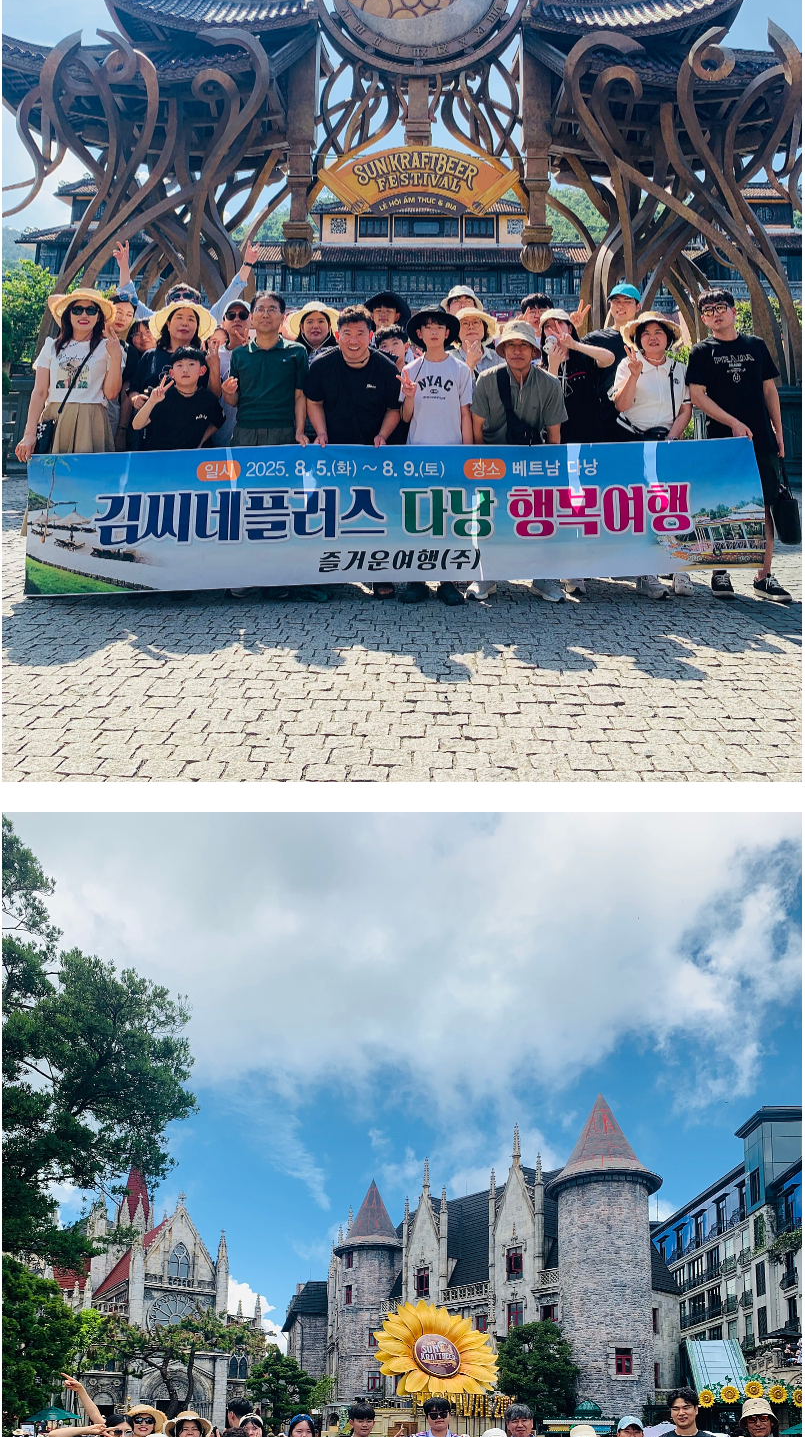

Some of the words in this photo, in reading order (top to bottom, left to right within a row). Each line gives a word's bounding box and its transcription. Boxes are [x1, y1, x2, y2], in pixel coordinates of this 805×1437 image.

[353, 157, 389, 185] SUN
[376, 172, 461, 192] FESTIVAL
[418, 376, 454, 392] NYAC
[205, 463, 233, 479] 일시
[246, 461, 288, 477] 2025.
[472, 461, 501, 477] 장소
[512, 459, 560, 476] 베트남
[568, 459, 598, 476] 다낭
[94, 488, 387, 546] 김씨네플러스
[402, 487, 495, 537] 다낭
[508, 482, 694, 538] 행복여행
[318, 548, 481, 573] 즐거운여행(주)
[422, 1344, 440, 1354] SUN
